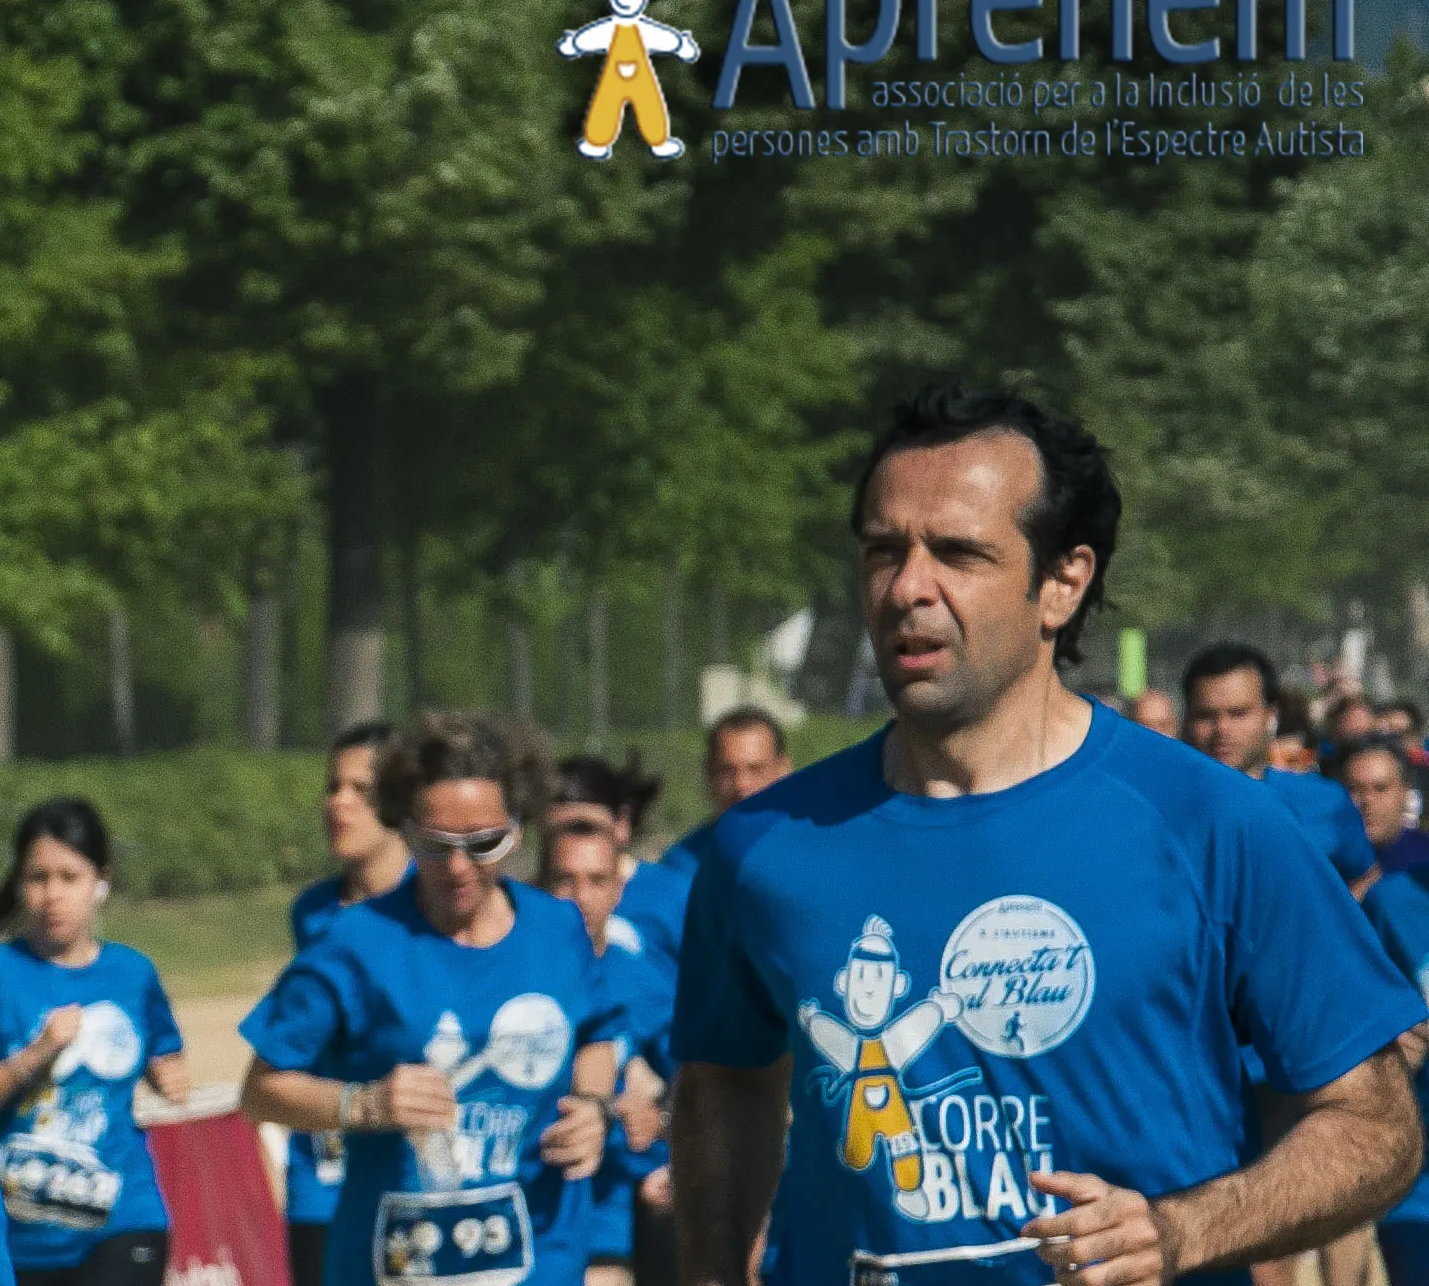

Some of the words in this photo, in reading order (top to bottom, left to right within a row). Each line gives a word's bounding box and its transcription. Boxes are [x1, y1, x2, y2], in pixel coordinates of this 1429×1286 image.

[963, 976, 992, 1010] al
[991, 973, 1073, 1007] Blau
[915, 1093, 1055, 1153] CORRE
[921, 1150, 1057, 1222] BLAU
[452, 1214, 512, 1259] 93
